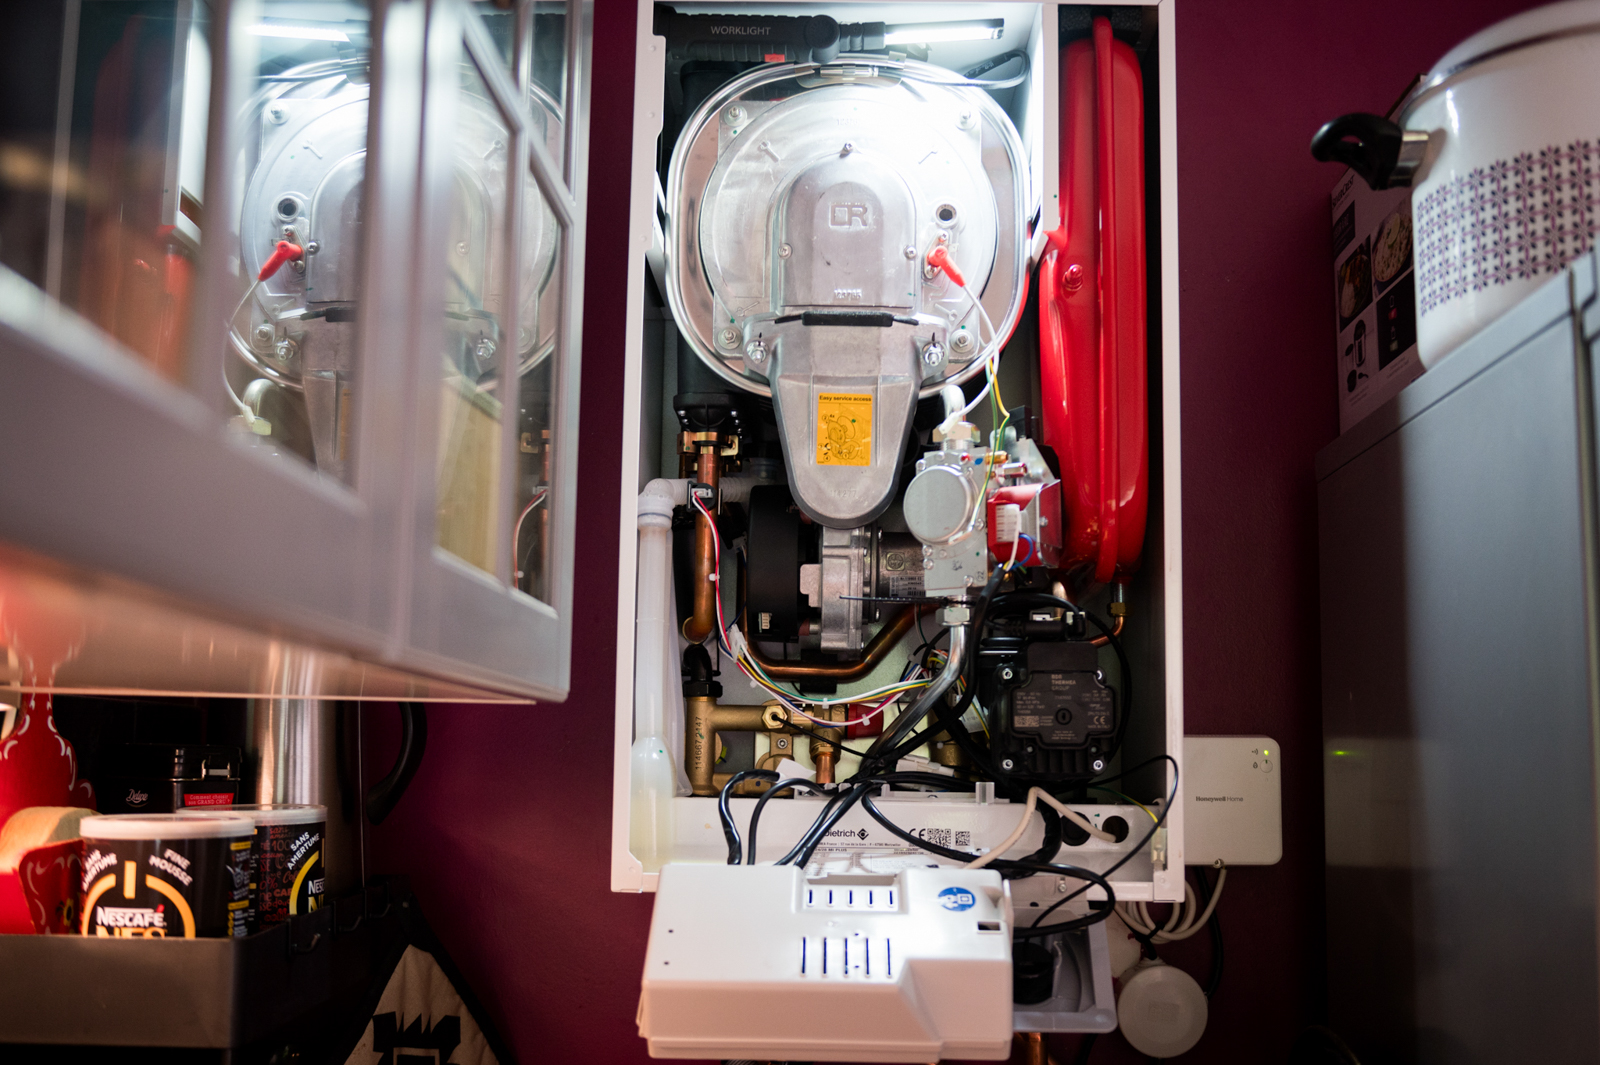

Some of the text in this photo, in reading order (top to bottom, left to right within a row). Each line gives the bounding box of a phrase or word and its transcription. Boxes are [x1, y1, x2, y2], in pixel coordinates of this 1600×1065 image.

[710, 26, 772, 36] WORKLIGHT
[286, 832, 320, 870] AMERTUME
[290, 832, 310, 852] SANS
[148, 854, 194, 887] MOUSSE
[164, 848, 192, 870] FINE
[96, 904, 165, 928] NESCAFÉ
